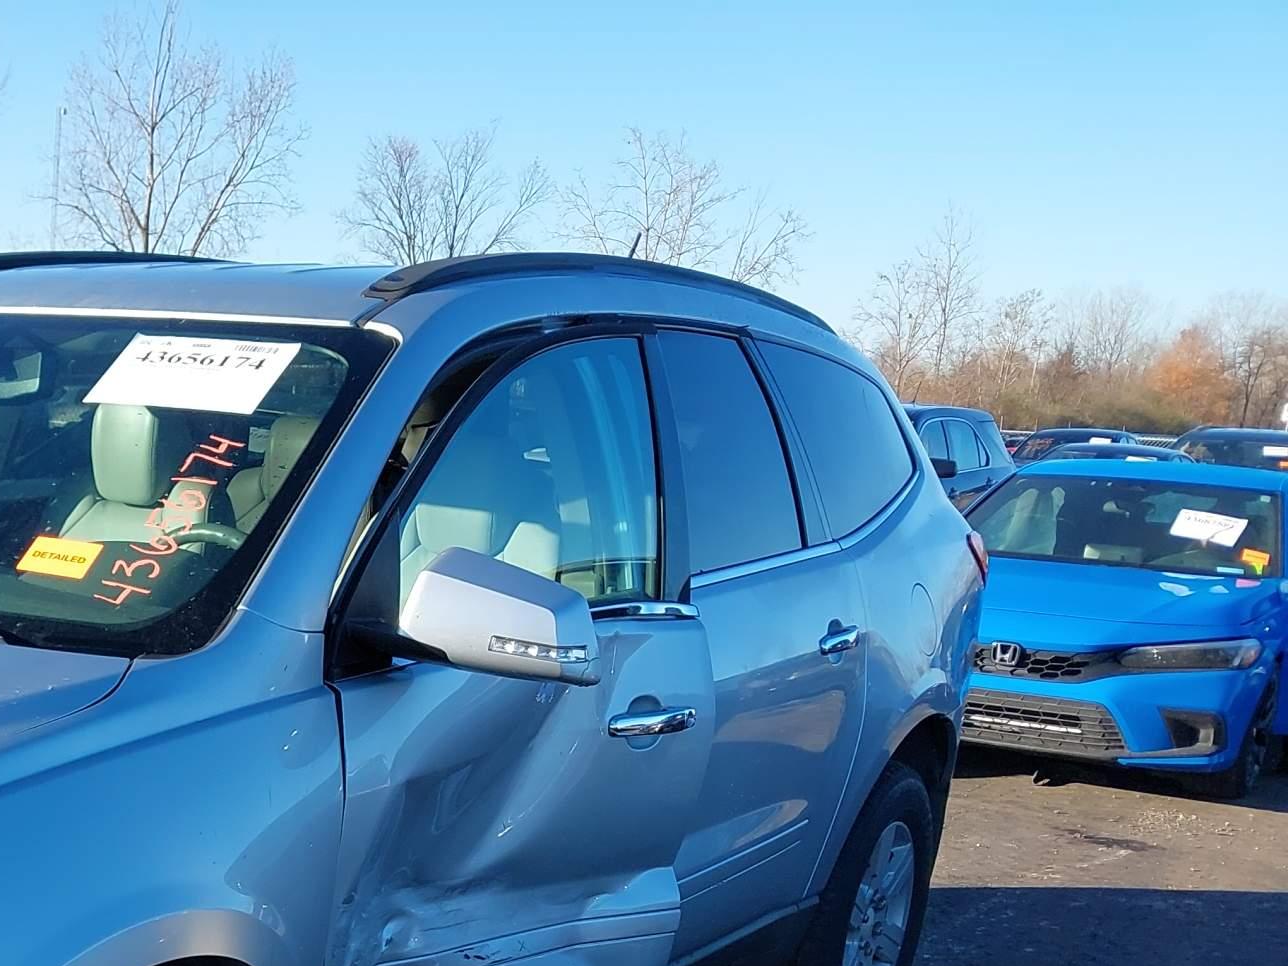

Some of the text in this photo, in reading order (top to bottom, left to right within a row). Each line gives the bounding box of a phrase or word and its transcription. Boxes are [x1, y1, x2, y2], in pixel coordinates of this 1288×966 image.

[135, 350, 266, 370] 43656174
[94, 434, 246, 605] 43656174
[32, 549, 87, 564] DETAILED
